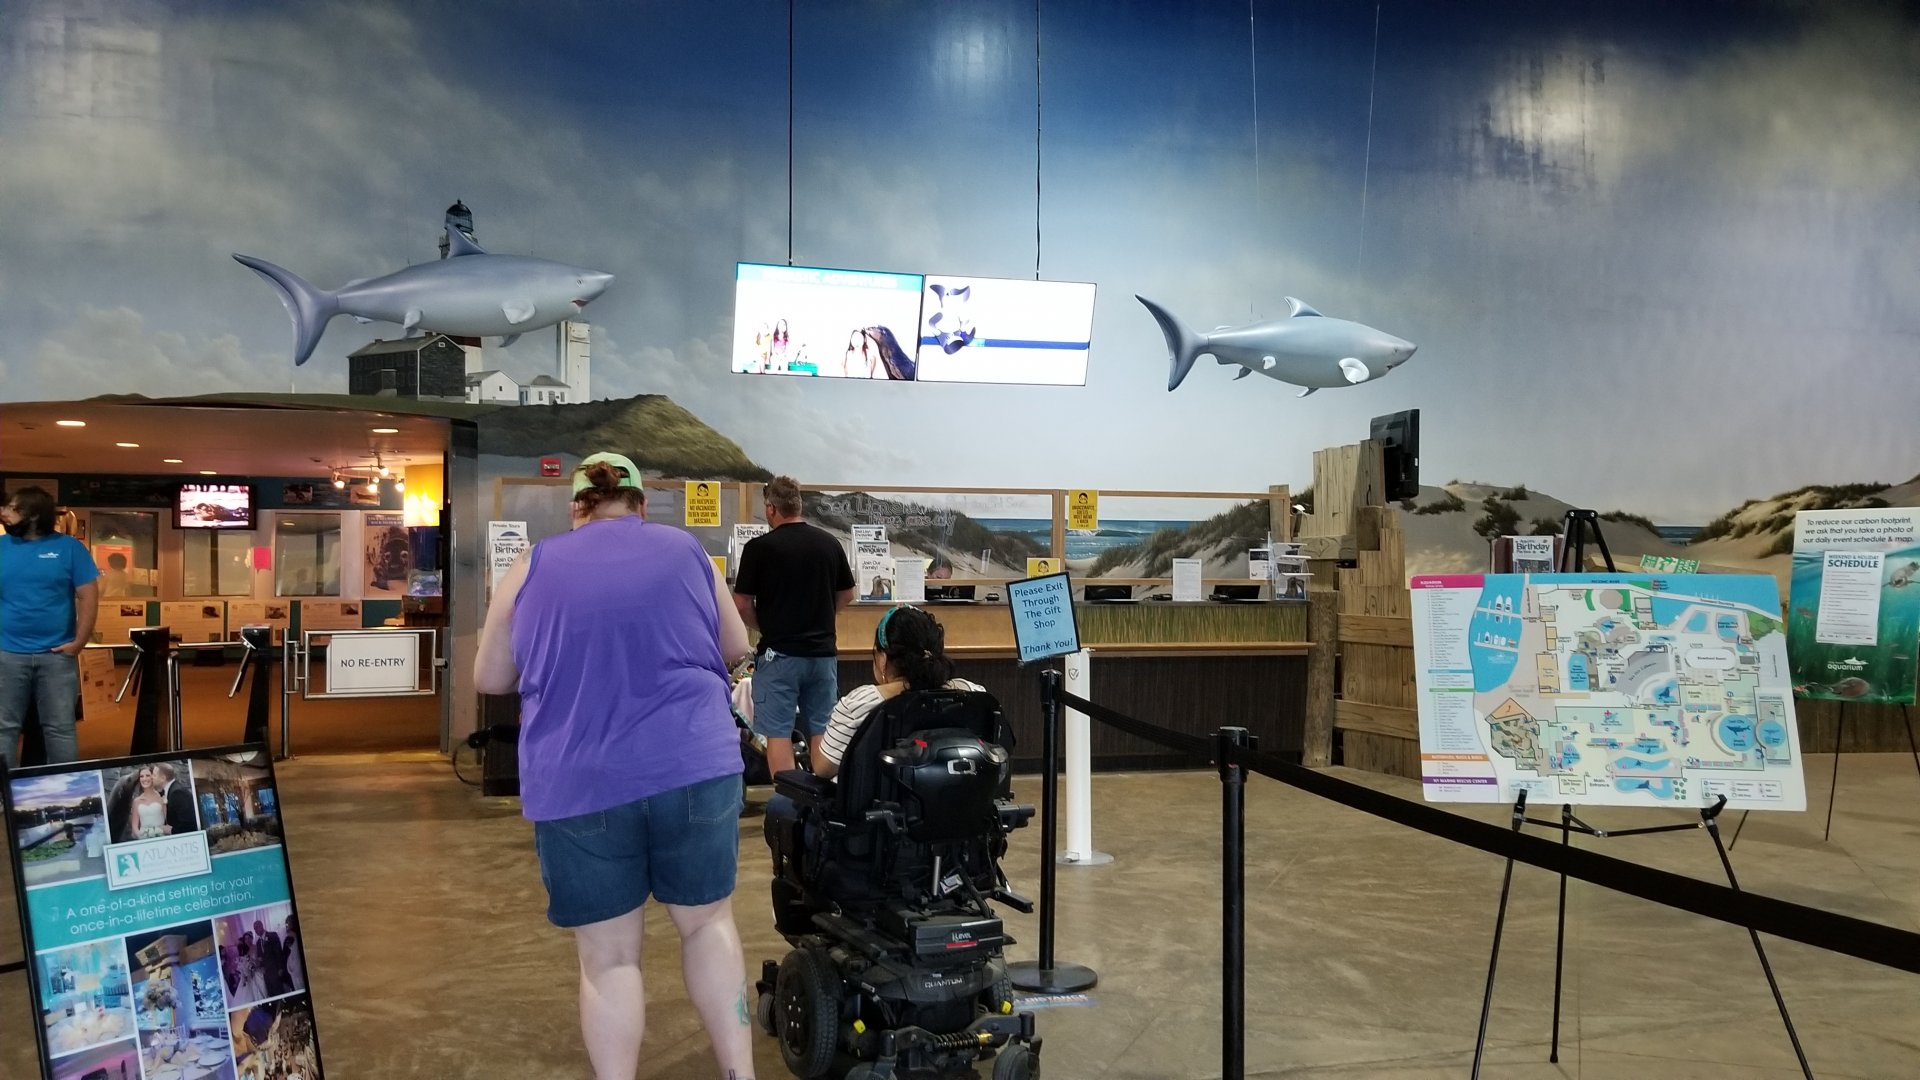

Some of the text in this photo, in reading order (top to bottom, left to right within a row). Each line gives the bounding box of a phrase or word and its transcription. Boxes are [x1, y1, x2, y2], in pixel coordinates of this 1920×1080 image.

[1883, 526, 1904, 534] photo
[1516, 543, 1550, 551] Birthday
[1828, 560, 1879, 569] SCHEDULE
[1014, 582, 1064, 598] Please Exit
[1022, 595, 1060, 608] Through
[1025, 606, 1062, 619] The Gift
[1034, 619, 1056, 629] Shop
[1023, 638, 1073, 654] Thank You!
[341, 657, 406, 668] NO RE-ENTRY
[1827, 663, 1864, 671] aquarium
[143, 842, 200, 862] ATLANTIS
[66, 875, 254, 920] A one-of-a-kind setting for your
[70, 890, 255, 935] once-in-a-lifetime celebration.
[924, 978, 963, 988] QUANTUM
